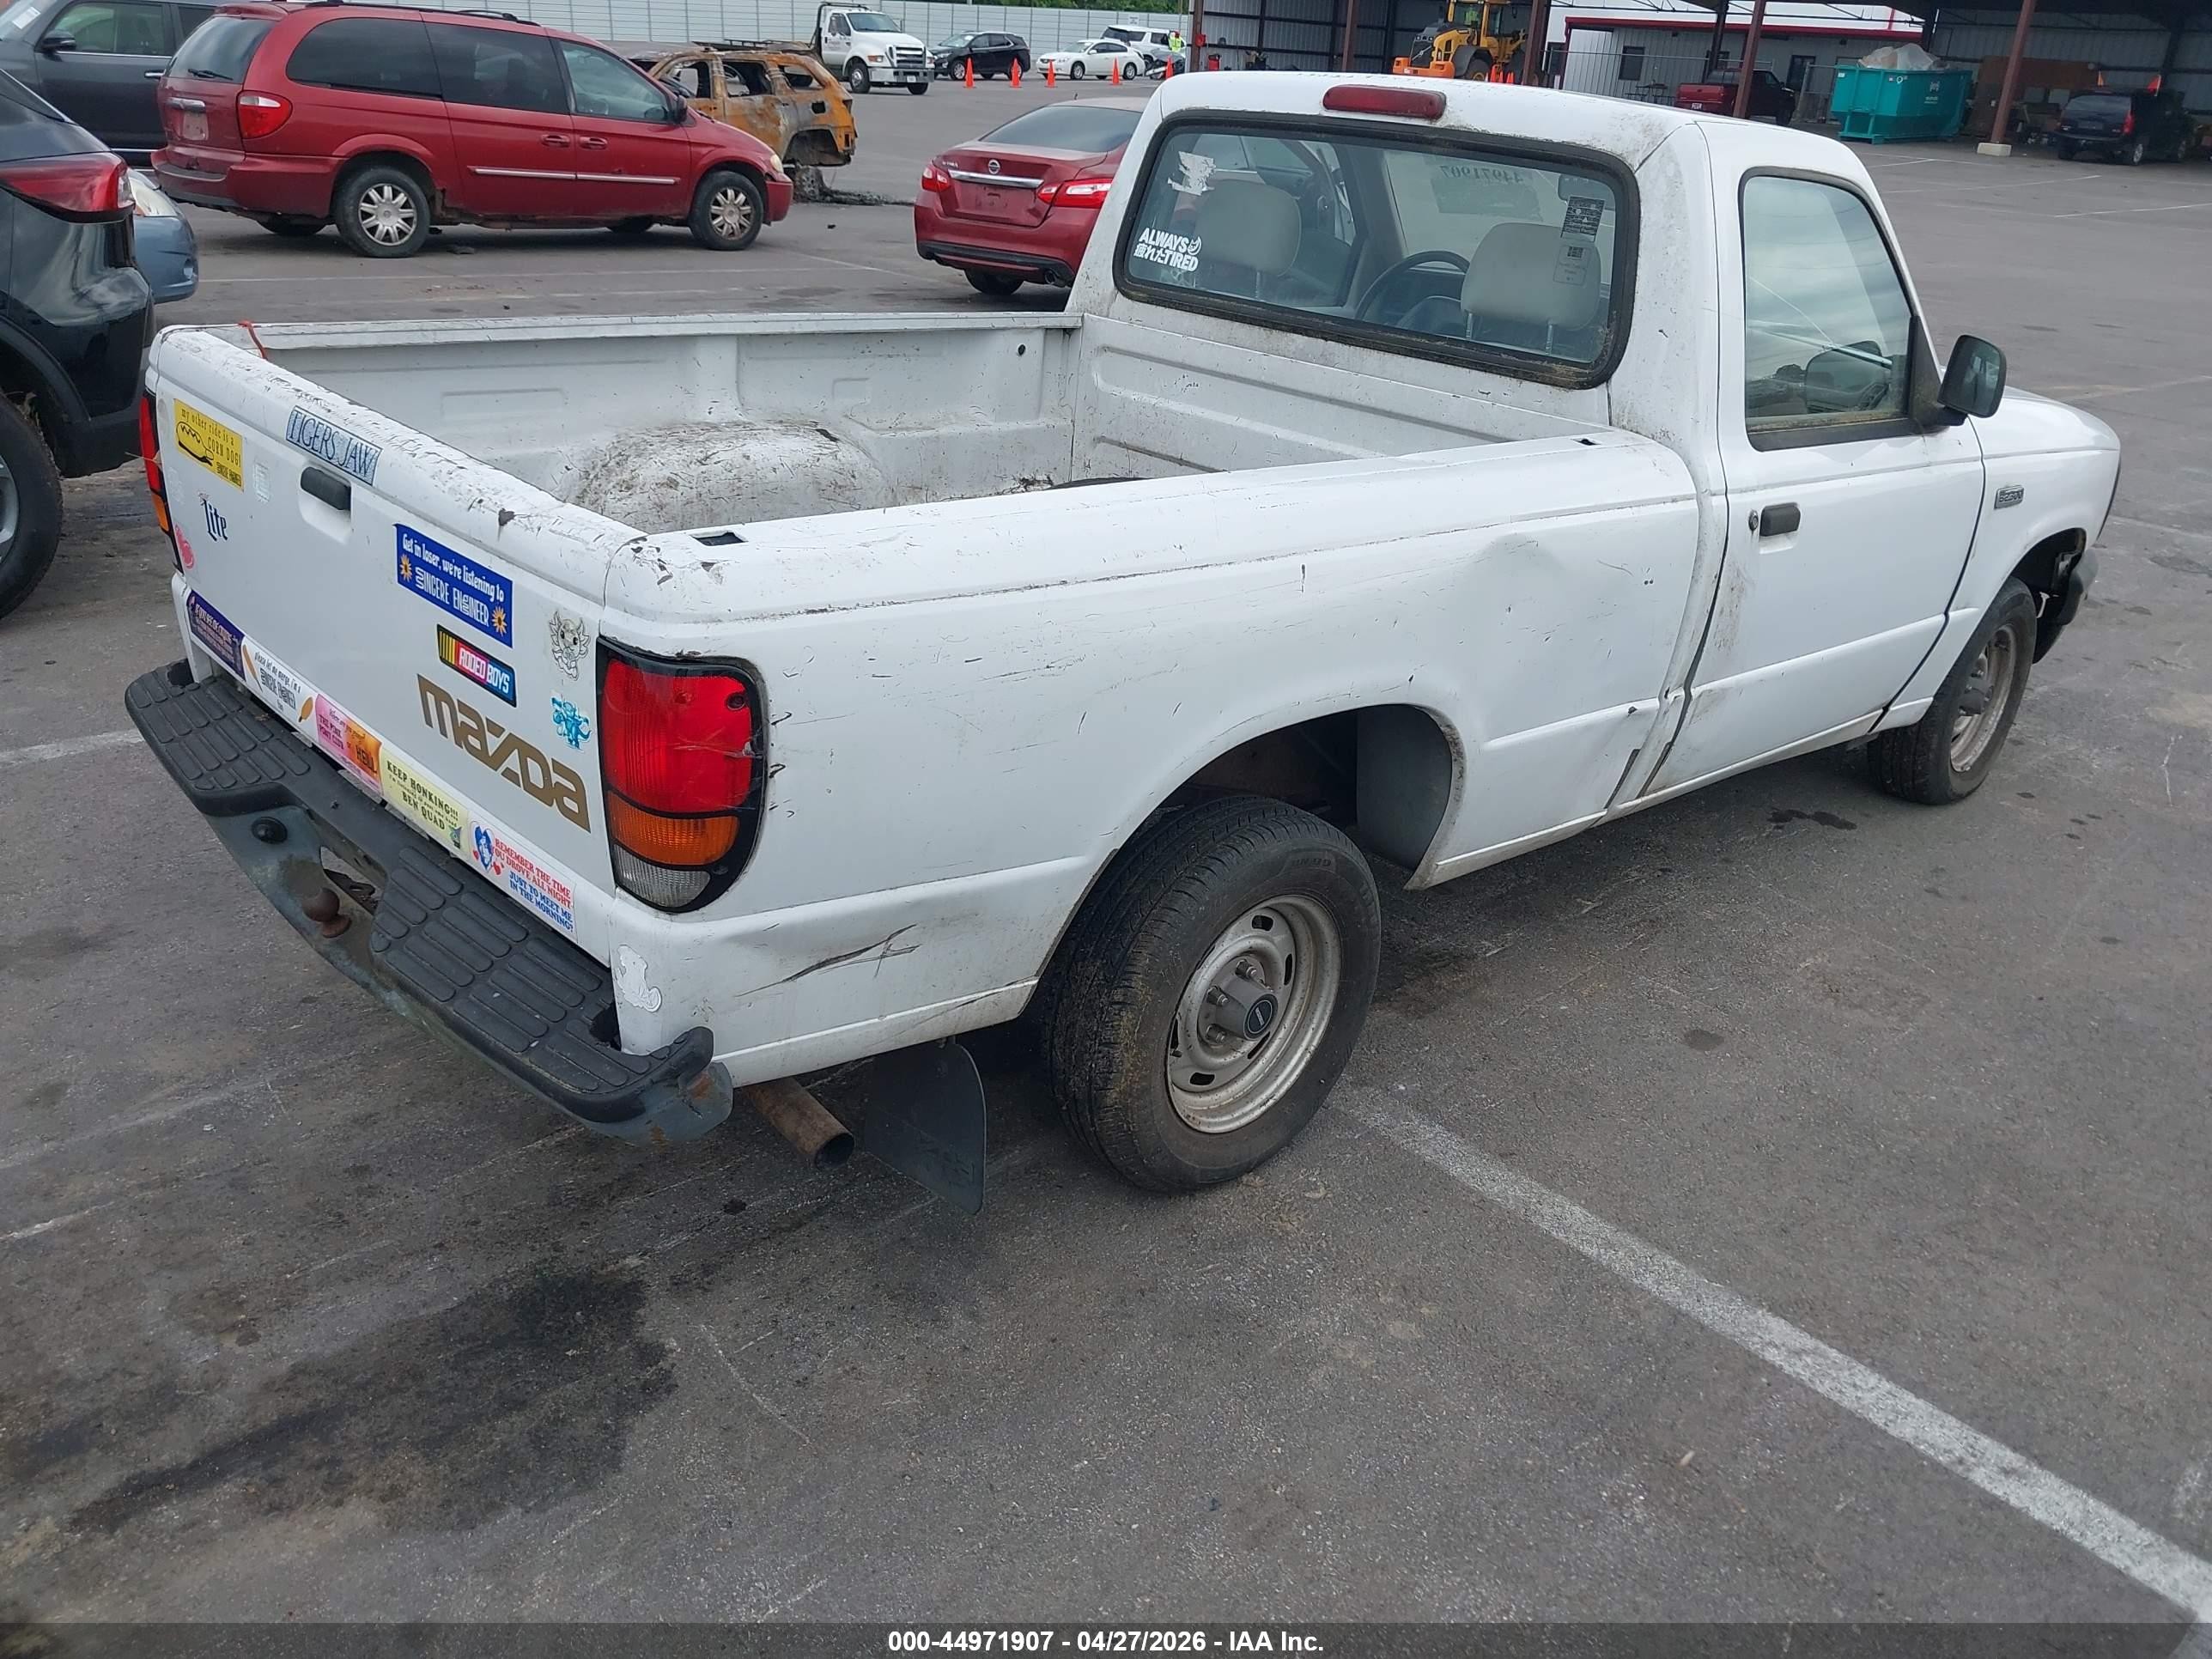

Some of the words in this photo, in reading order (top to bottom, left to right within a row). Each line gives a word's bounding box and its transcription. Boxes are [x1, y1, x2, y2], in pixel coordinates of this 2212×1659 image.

[1139, 227, 1190, 253] ALWAYS
[289, 410, 340, 460] TIGERS
[337, 437, 379, 477] JAW
[201, 498, 228, 542] Lite
[402, 533, 414, 554] Get
[414, 540, 422, 556] in
[422, 544, 441, 570] loser,
[442, 558, 462, 580] we're
[462, 563, 495, 603] listening
[496, 583, 504, 603] to
[415, 567, 450, 605] SINCERE
[453, 586, 489, 628] ENGINEER
[486, 664, 511, 694] BOYS
[386, 760, 407, 782] KEEP
[410, 777, 459, 821] HONKING!!!
[402, 791, 419, 811] BEN
[421, 805, 445, 830] QUAD
[495, 838, 535, 874] REMEMBER
[536, 867, 551, 884] THE
[551, 879, 571, 899] TIME
[506, 855, 532, 880] DROVE
[532, 878, 547, 891] ALL
[547, 885, 571, 909] NIGHT
[509, 871, 527, 890] JUST
[529, 884, 538, 896] TO
[539, 893, 560, 913] MEET
[561, 907, 573, 922] ME
[510, 879, 519, 891] IN
[519, 886, 534, 903] THE
[535, 897, 573, 933] MORNING?
